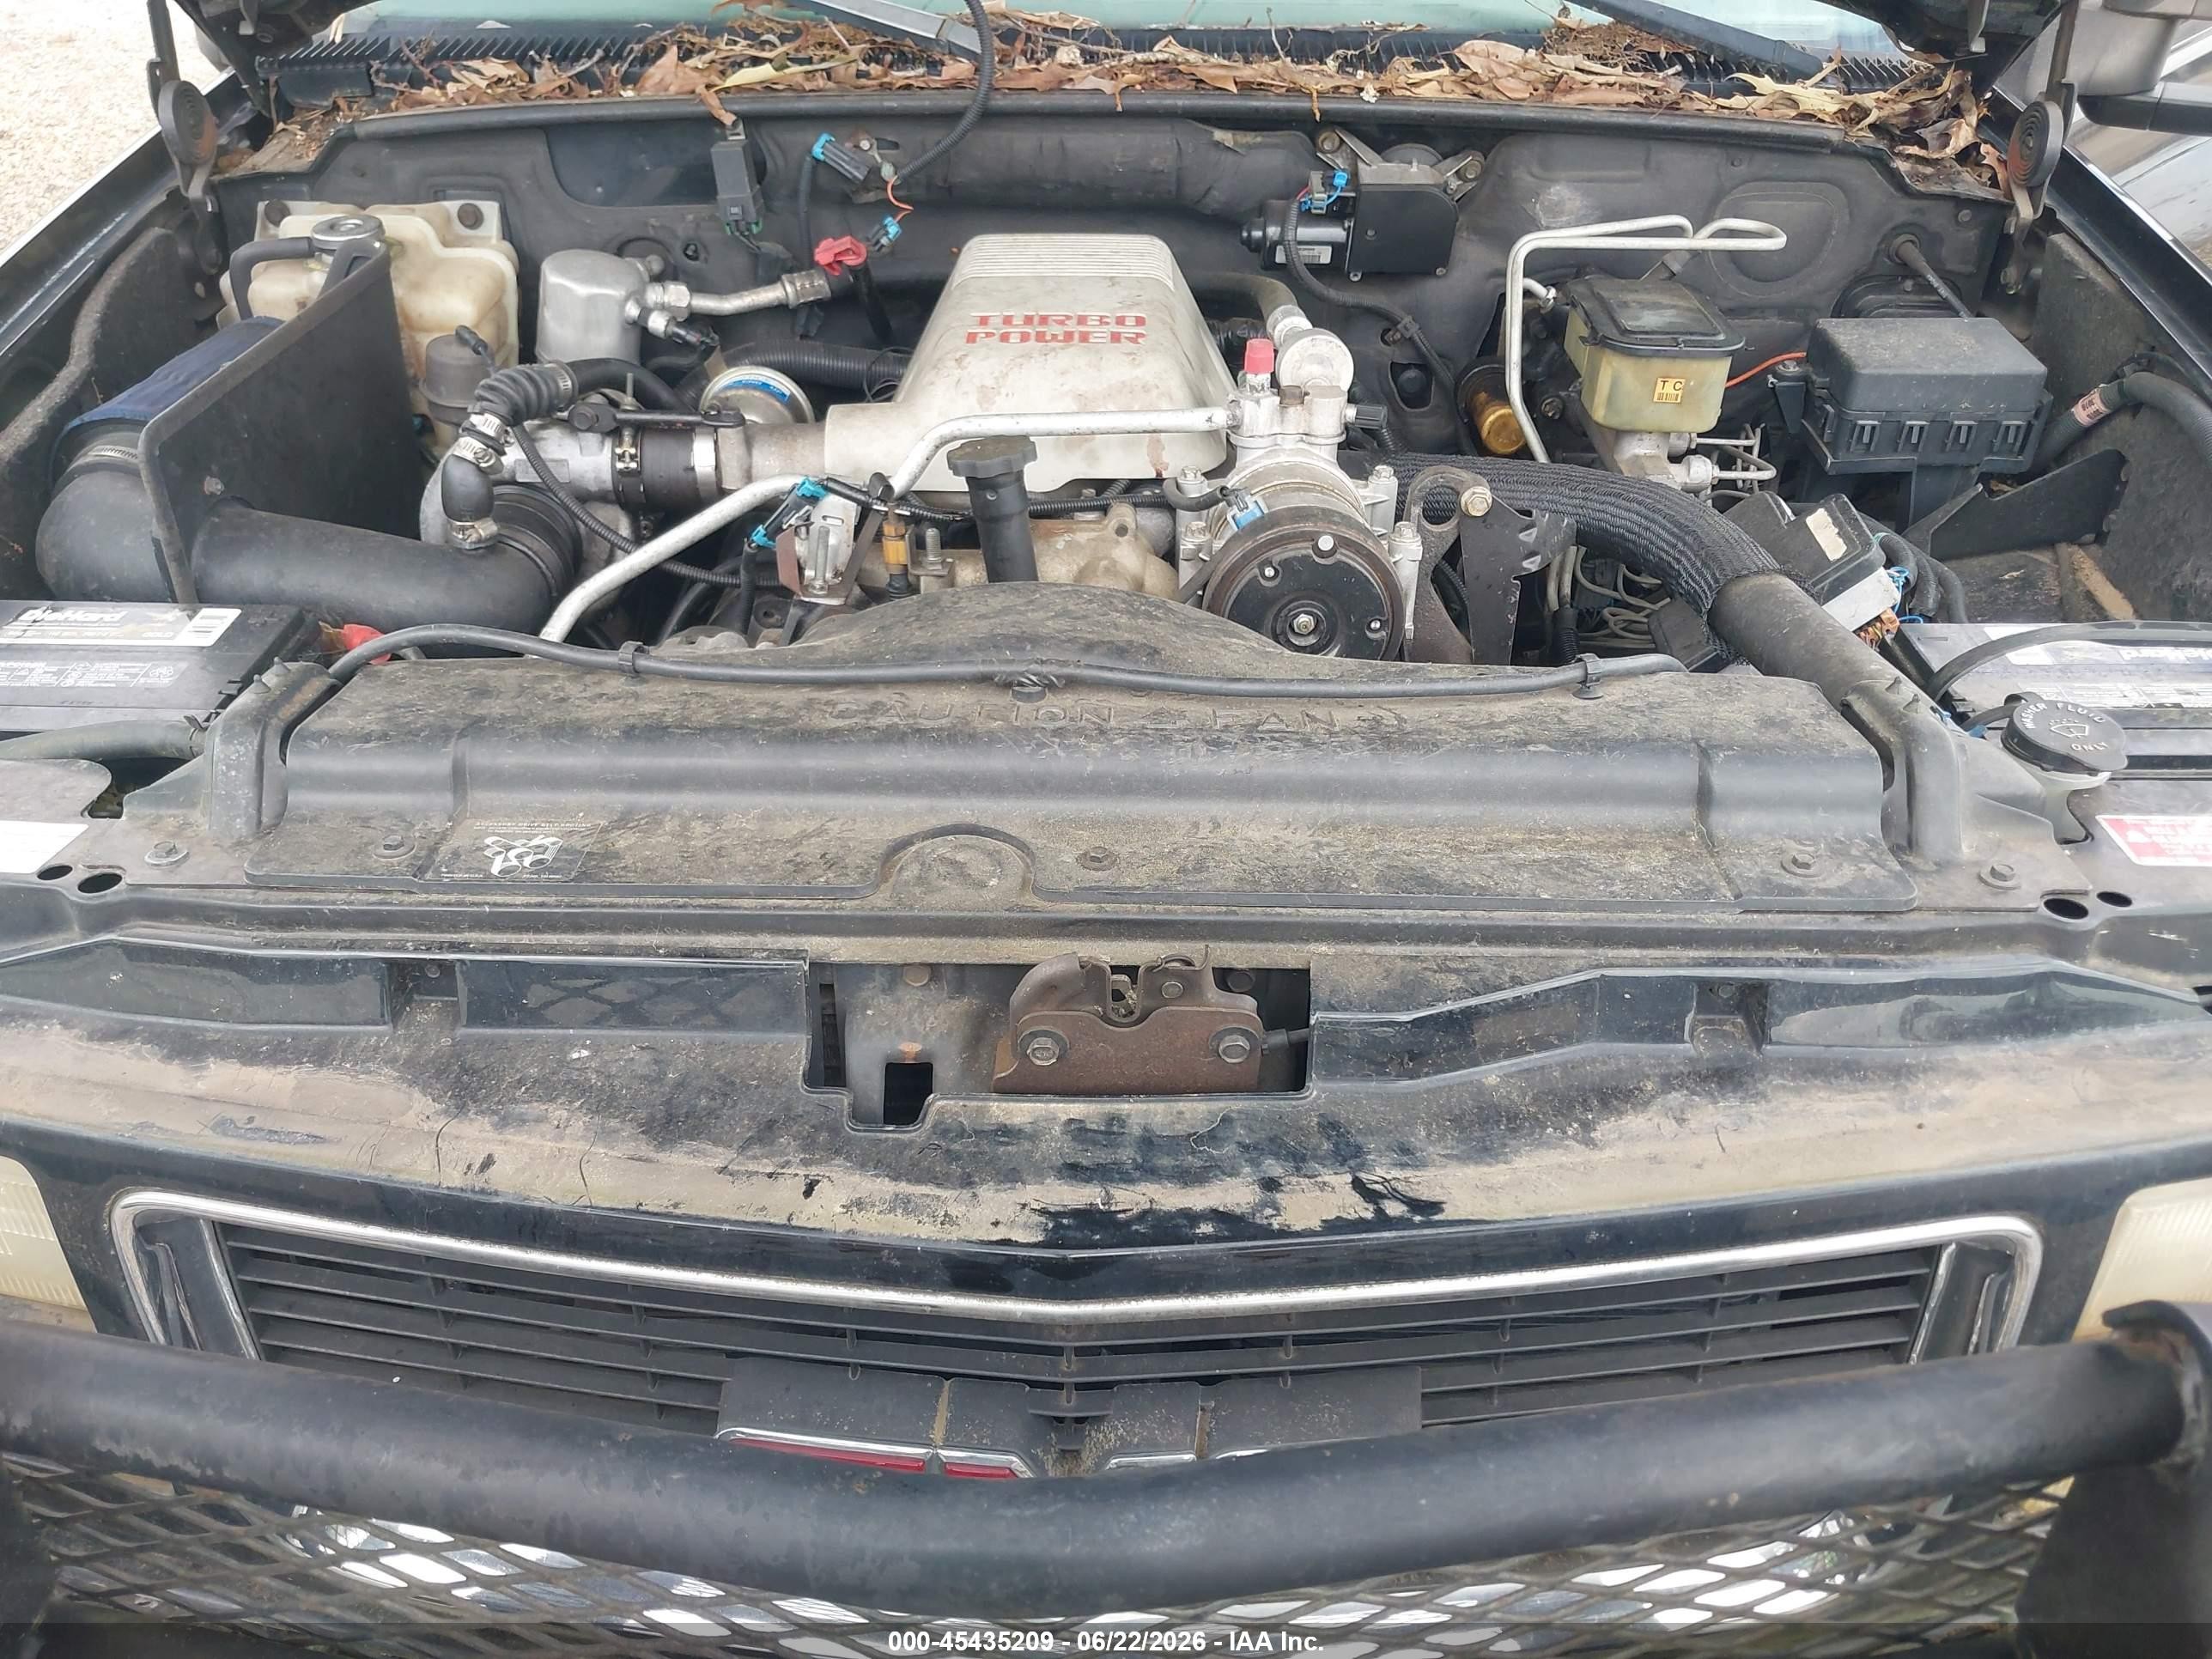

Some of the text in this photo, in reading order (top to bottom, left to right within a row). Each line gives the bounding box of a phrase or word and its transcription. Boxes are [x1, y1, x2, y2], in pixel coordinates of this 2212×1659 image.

[970, 312, 1147, 328] TURBO
[964, 329, 1147, 344] POWER
[18, 608, 129, 622] DieHard
[1209, 708, 1340, 732] FAN
[2021, 702, 2107, 729] WASHER FLUID
[2070, 741, 2110, 752] ONLY
